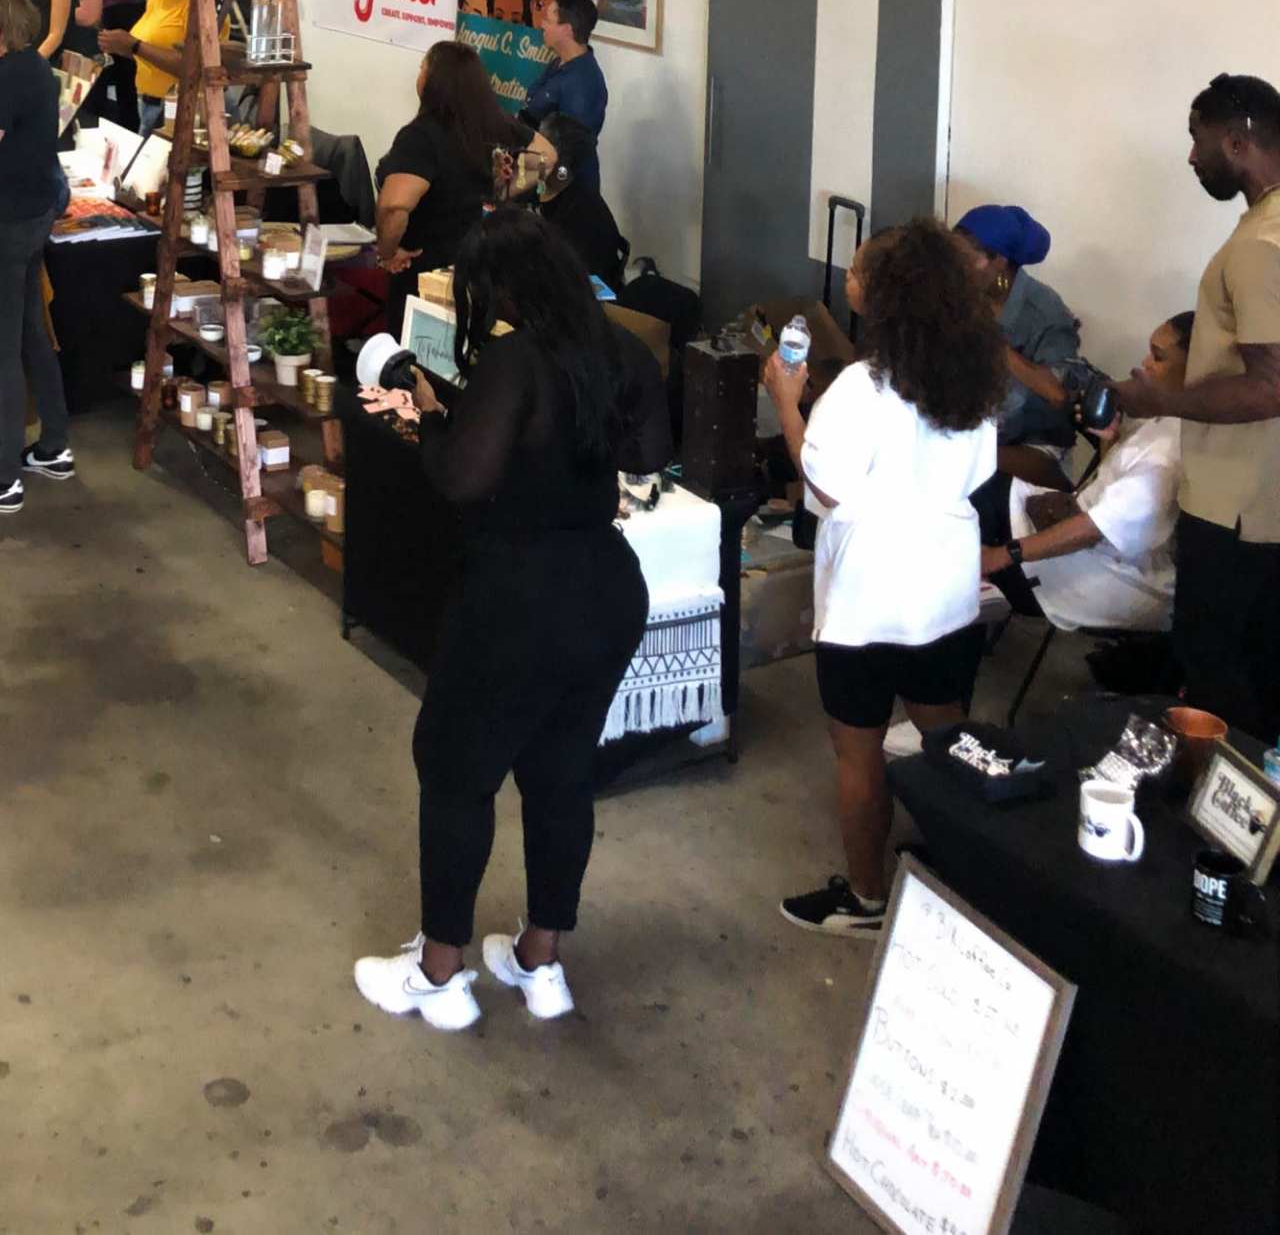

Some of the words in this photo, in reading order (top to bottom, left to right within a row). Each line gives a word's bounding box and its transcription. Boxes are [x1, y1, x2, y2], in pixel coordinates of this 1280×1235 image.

[1212, 790, 1248, 829] Coffee
[1218, 772, 1252, 813] Black
[1193, 868, 1227, 899] DOPE
